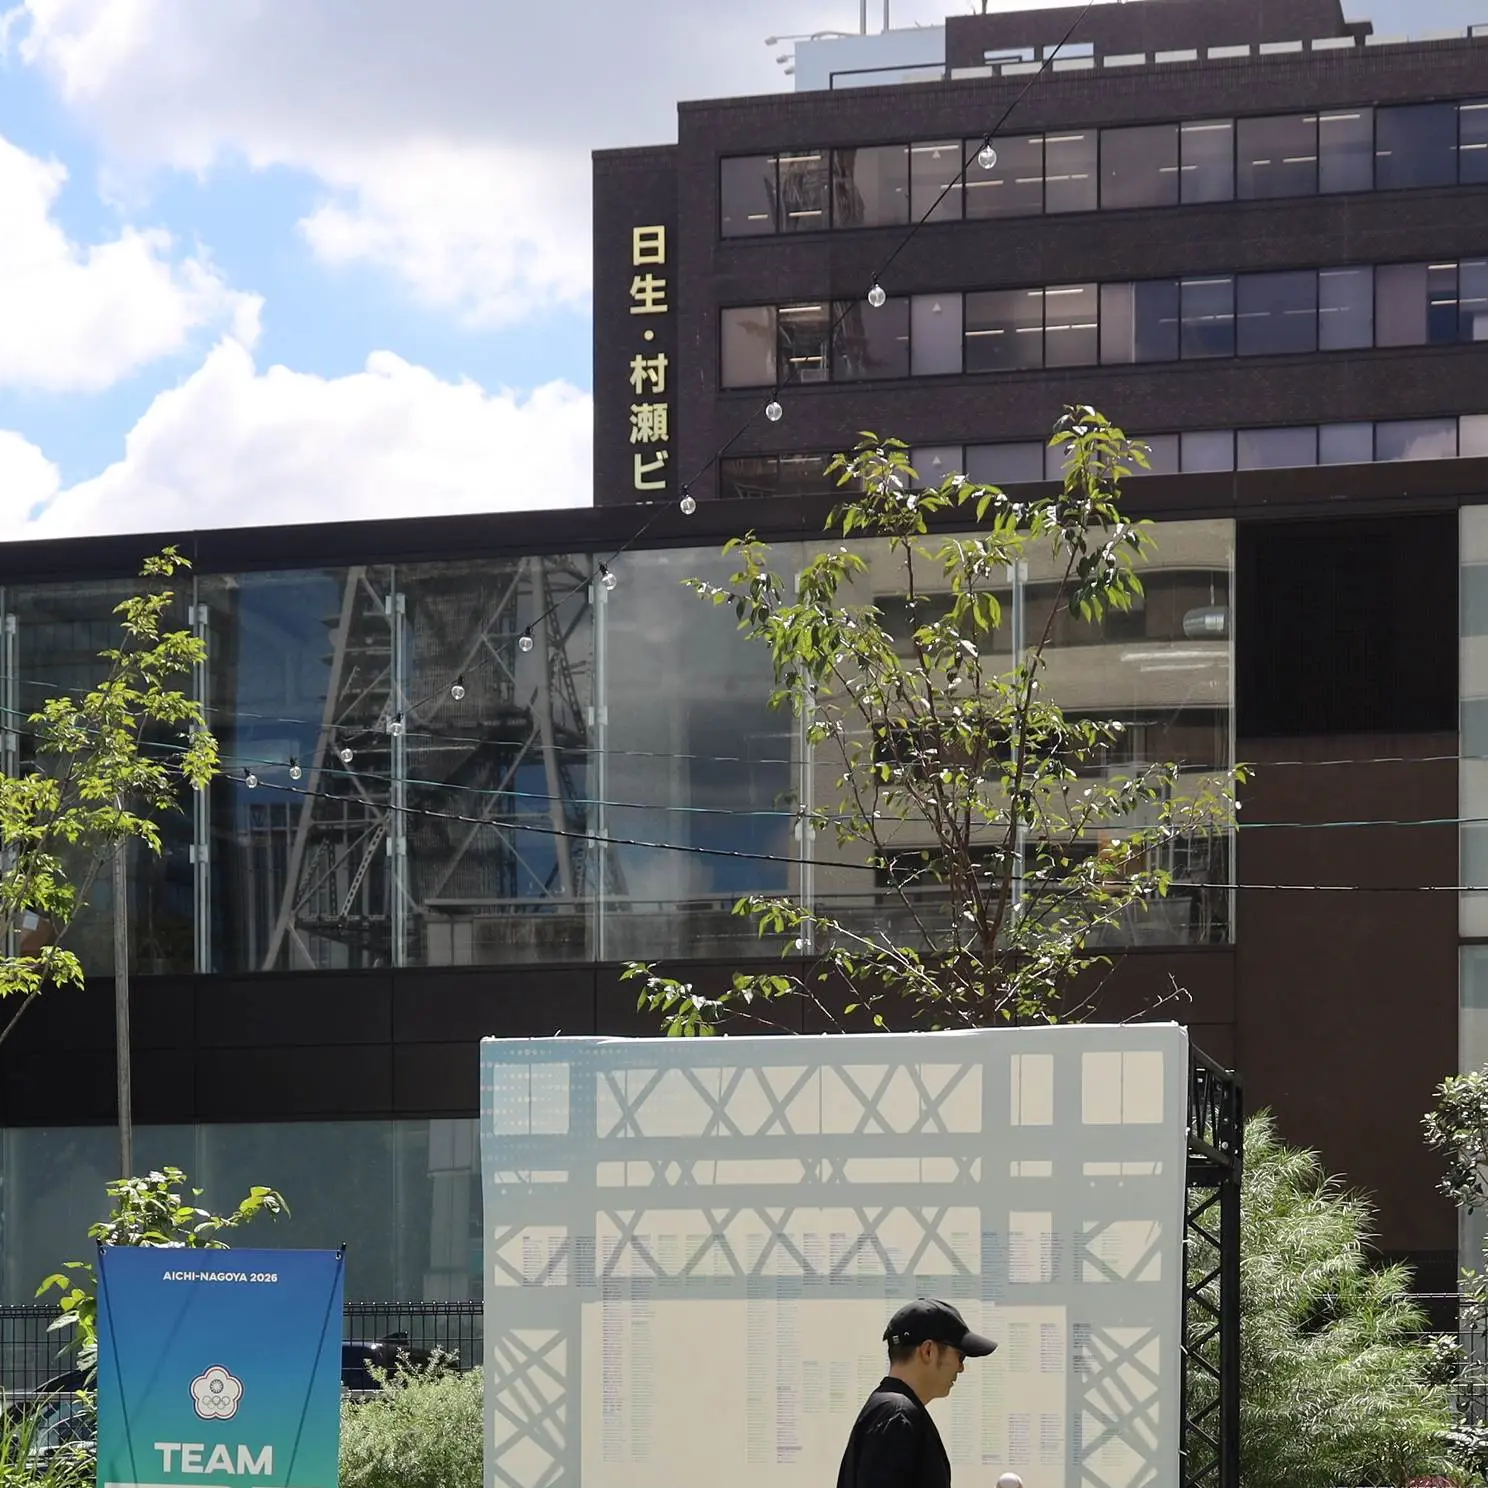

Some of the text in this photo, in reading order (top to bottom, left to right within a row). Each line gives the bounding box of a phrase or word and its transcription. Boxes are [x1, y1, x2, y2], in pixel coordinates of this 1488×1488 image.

[629, 225, 669, 504] 日生・村瀬ビ
[162, 1271, 278, 1283] AICHI-NAGOYA 2026
[154, 1442, 273, 1475] TEAM
